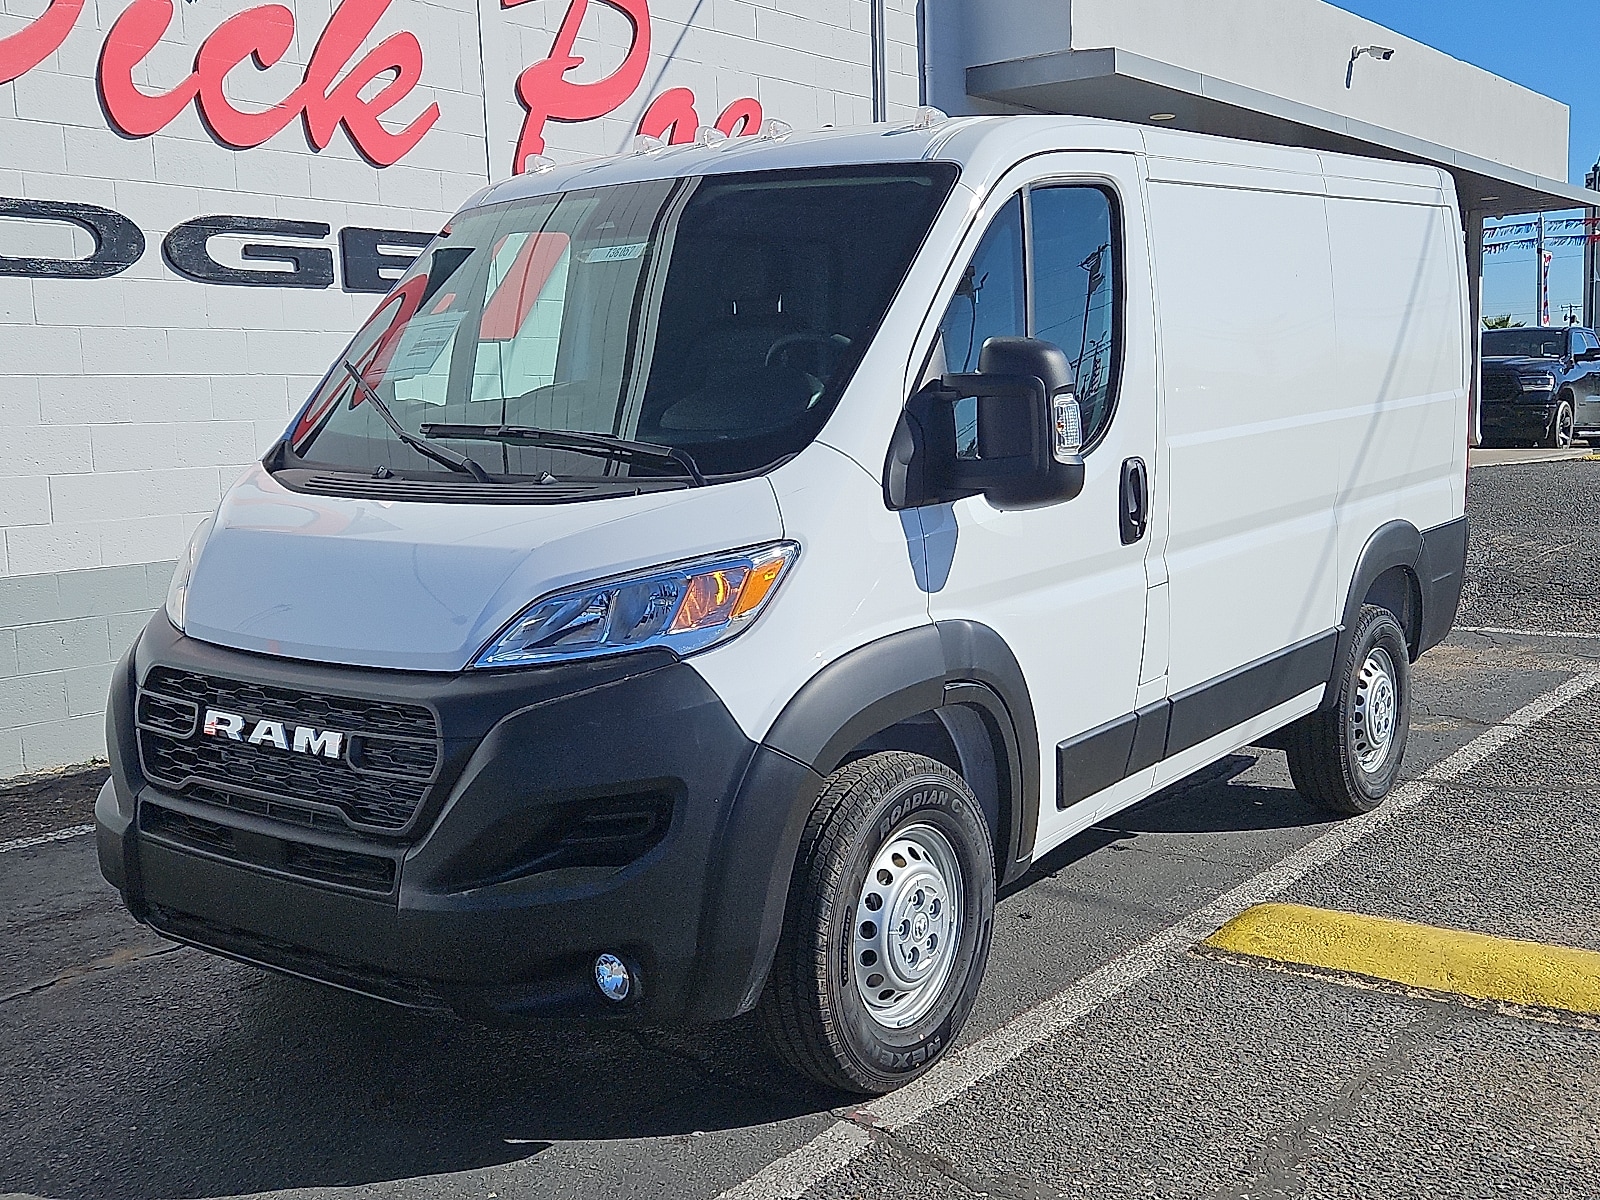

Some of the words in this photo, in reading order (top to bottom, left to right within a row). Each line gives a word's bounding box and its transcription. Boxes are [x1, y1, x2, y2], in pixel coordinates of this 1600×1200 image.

[203, 709, 344, 760] RAM
[880, 790, 949, 840] ROADIAN
[867, 1035, 941, 1068] NEXEN
